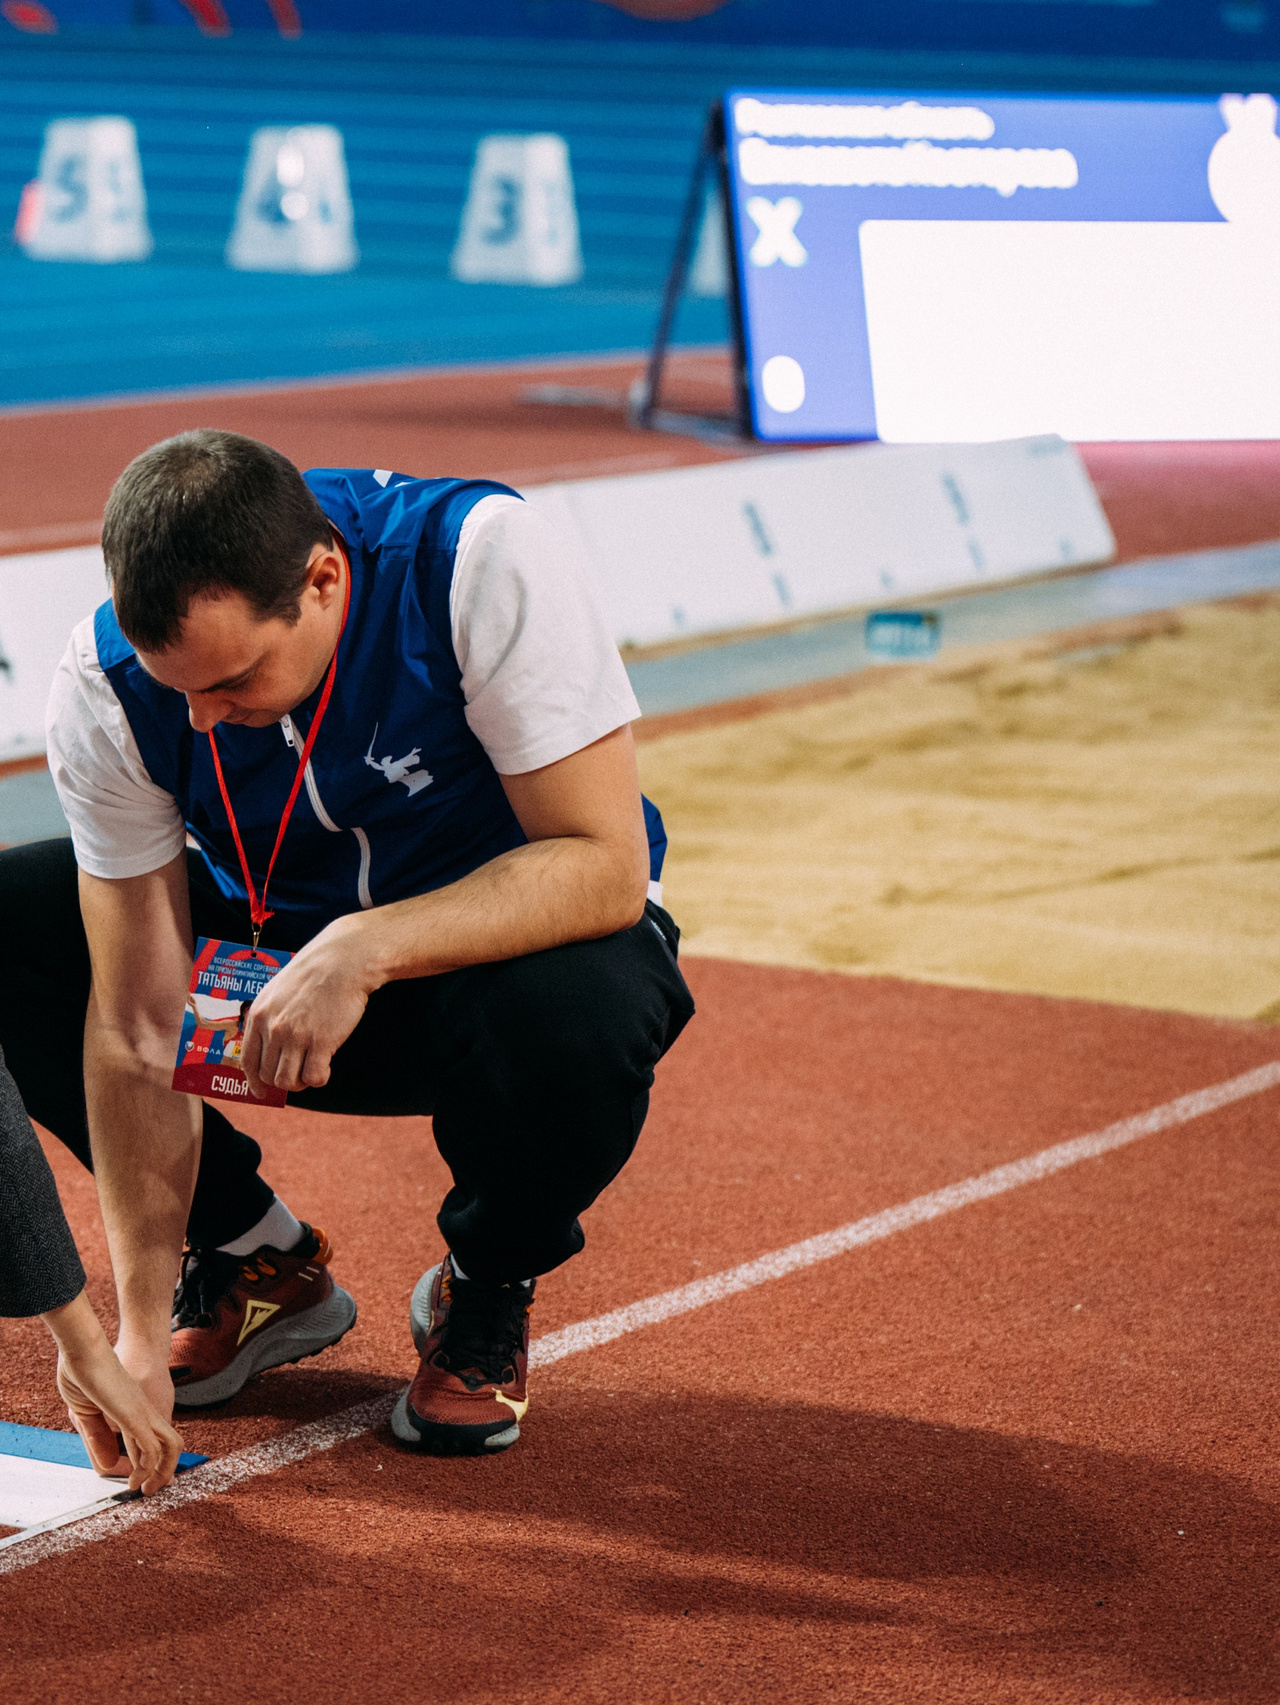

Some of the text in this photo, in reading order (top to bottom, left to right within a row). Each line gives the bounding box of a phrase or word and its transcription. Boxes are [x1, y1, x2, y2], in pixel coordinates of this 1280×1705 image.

[51, 154, 89, 222] 5
[481, 172, 523, 246] 3
[207, 964, 216, 972] НА
[216, 966, 232, 975] ПРИЗЫ
[232, 967, 266, 980] ОЛИМПИЙСКОЙ
[213, 956, 253, 969] ВСЕРОССИЙСКИЕ
[198, 971, 243, 992] ТАТЬЯНЫ
[197, 1045, 221, 1055] ВФЛА
[211, 1075, 249, 1096] СУДЬЯ
